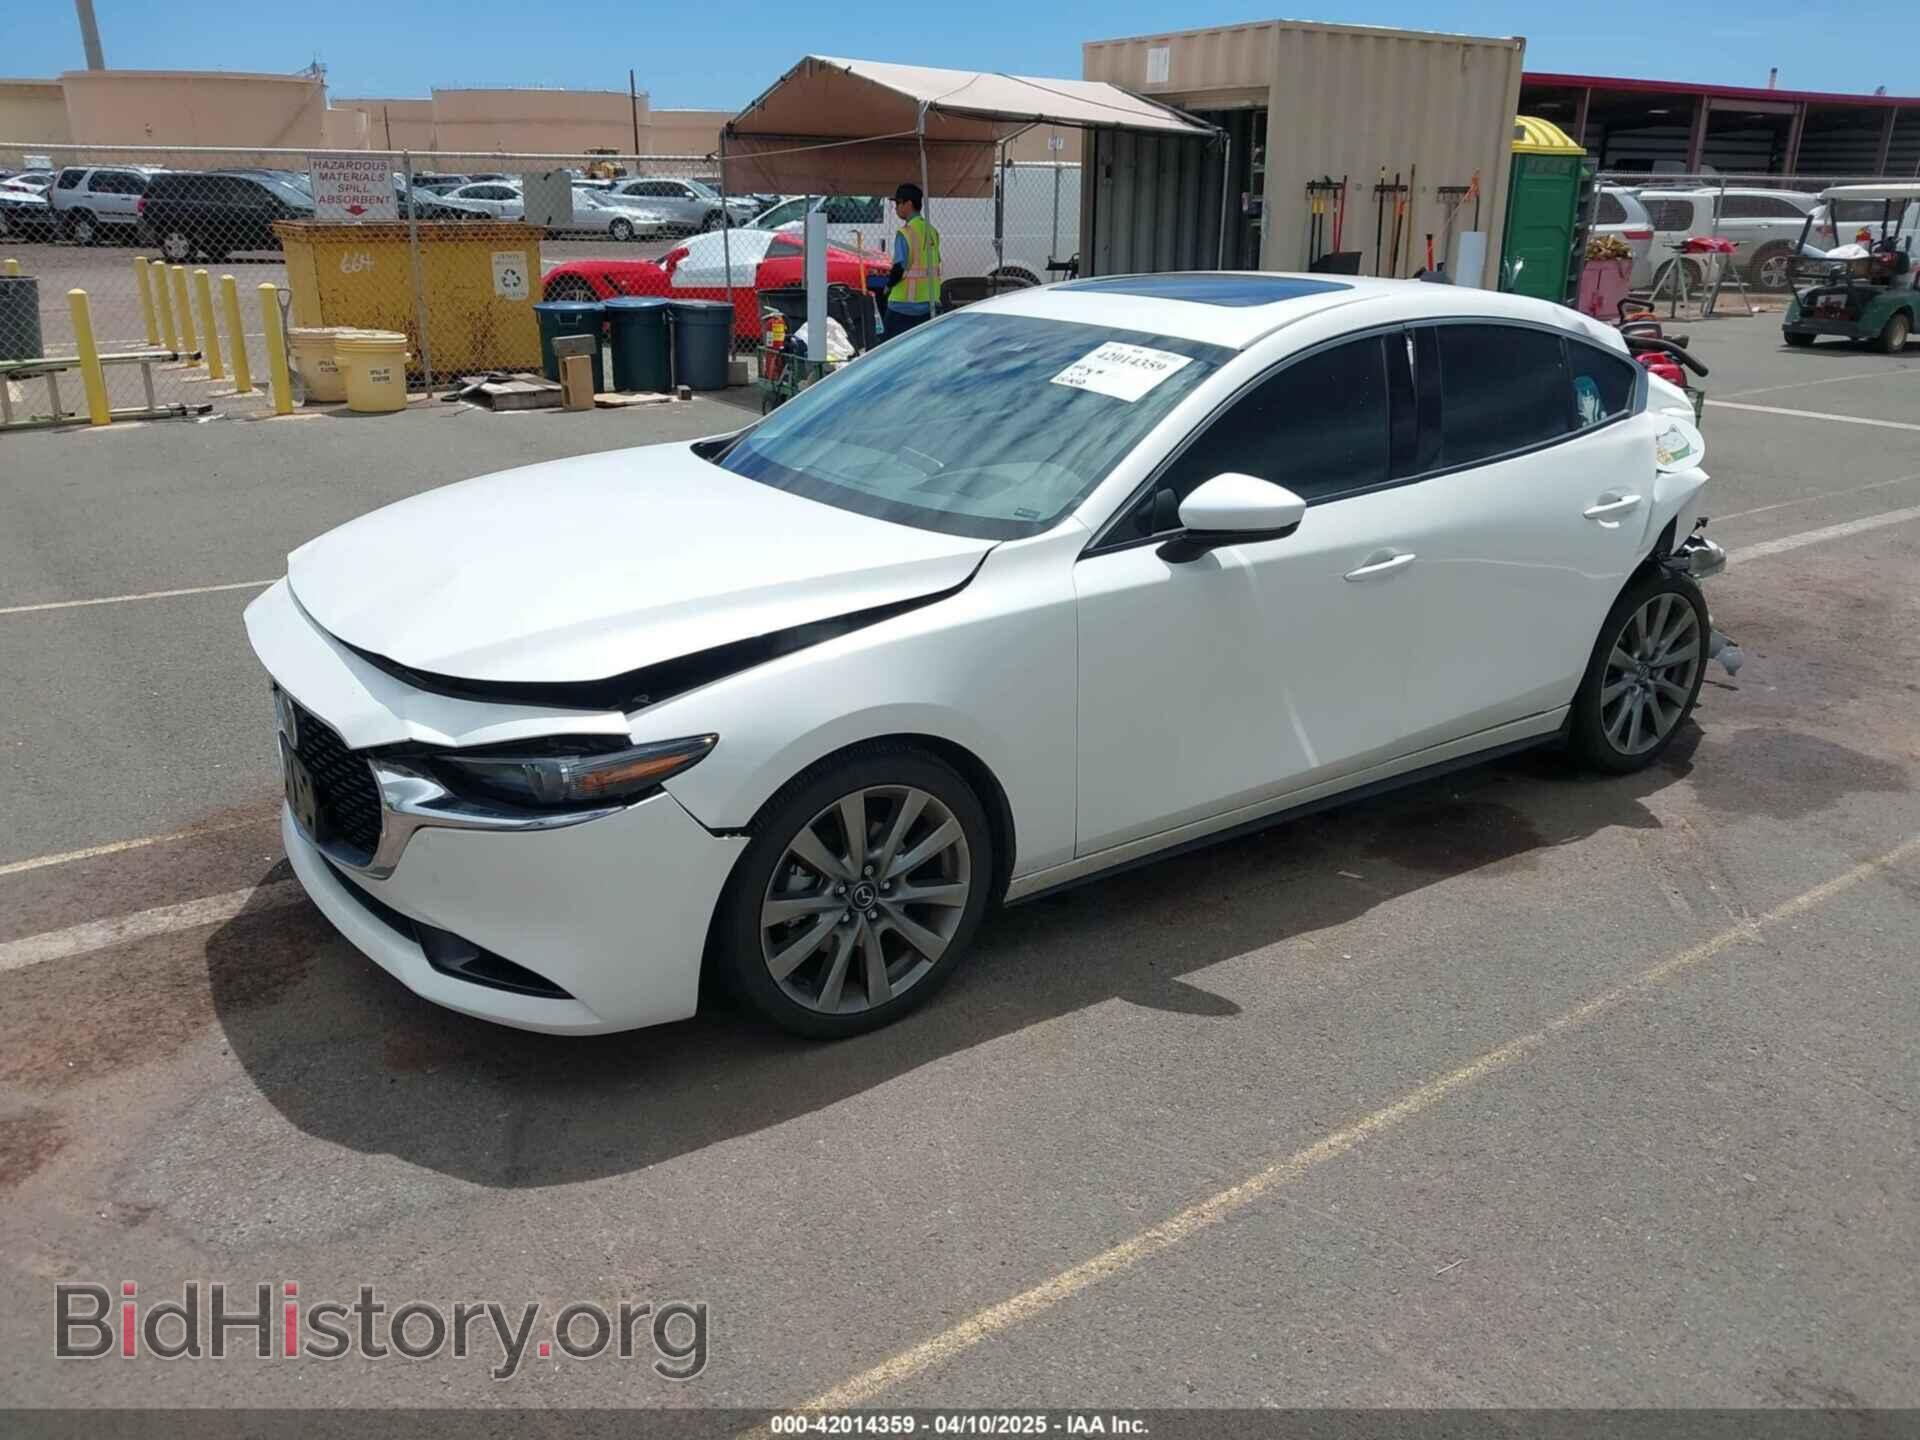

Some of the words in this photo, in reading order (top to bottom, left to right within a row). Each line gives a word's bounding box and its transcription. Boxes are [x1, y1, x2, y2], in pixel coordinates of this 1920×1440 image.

[313, 160, 388, 171] HAZARDOUS
[319, 172, 385, 182] MATERIALS
[337, 183, 369, 193] SPILL
[319, 195, 391, 205] ABSORBENT
[341, 250, 375, 273] 664
